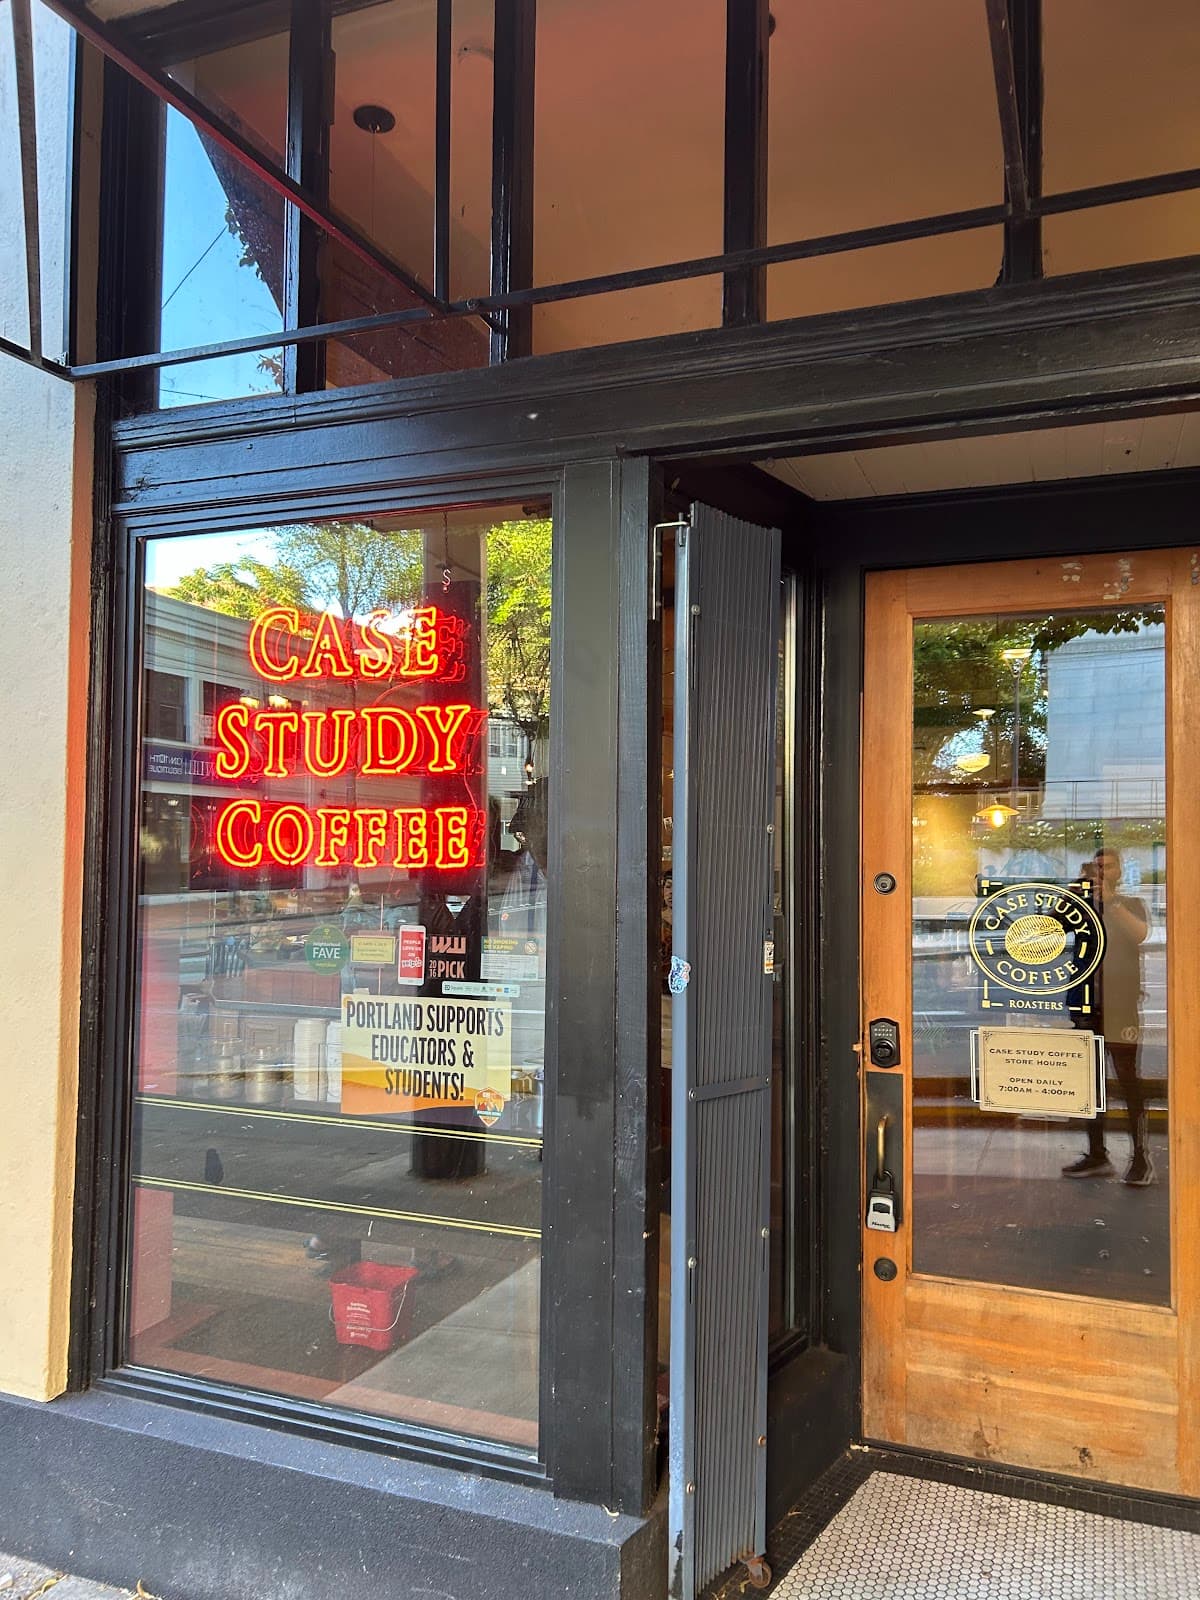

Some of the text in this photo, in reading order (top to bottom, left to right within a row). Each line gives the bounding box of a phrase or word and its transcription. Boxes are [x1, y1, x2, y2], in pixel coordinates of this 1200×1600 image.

[249, 606, 439, 681] CASE
[215, 704, 472, 779] STUDY
[216, 799, 470, 869] COFFEE
[985, 892, 1091, 936] CASE STUDY
[312, 947, 342, 959] FAVE
[437, 960, 466, 979] PICK
[996, 960, 1079, 985] COFFEE
[346, 1000, 504, 1036] PORTLAND SUPPORTS
[1009, 999, 1064, 1011] ROASTERS
[371, 1034, 475, 1068] EDUCATORS &
[1047, 1051, 1084, 1059] COFFEE
[384, 1068, 465, 1101] STUDENTS!
[998, 1085, 1032, 1093] 7:00AM
[1041, 1088, 1076, 1096] 4:00PM
